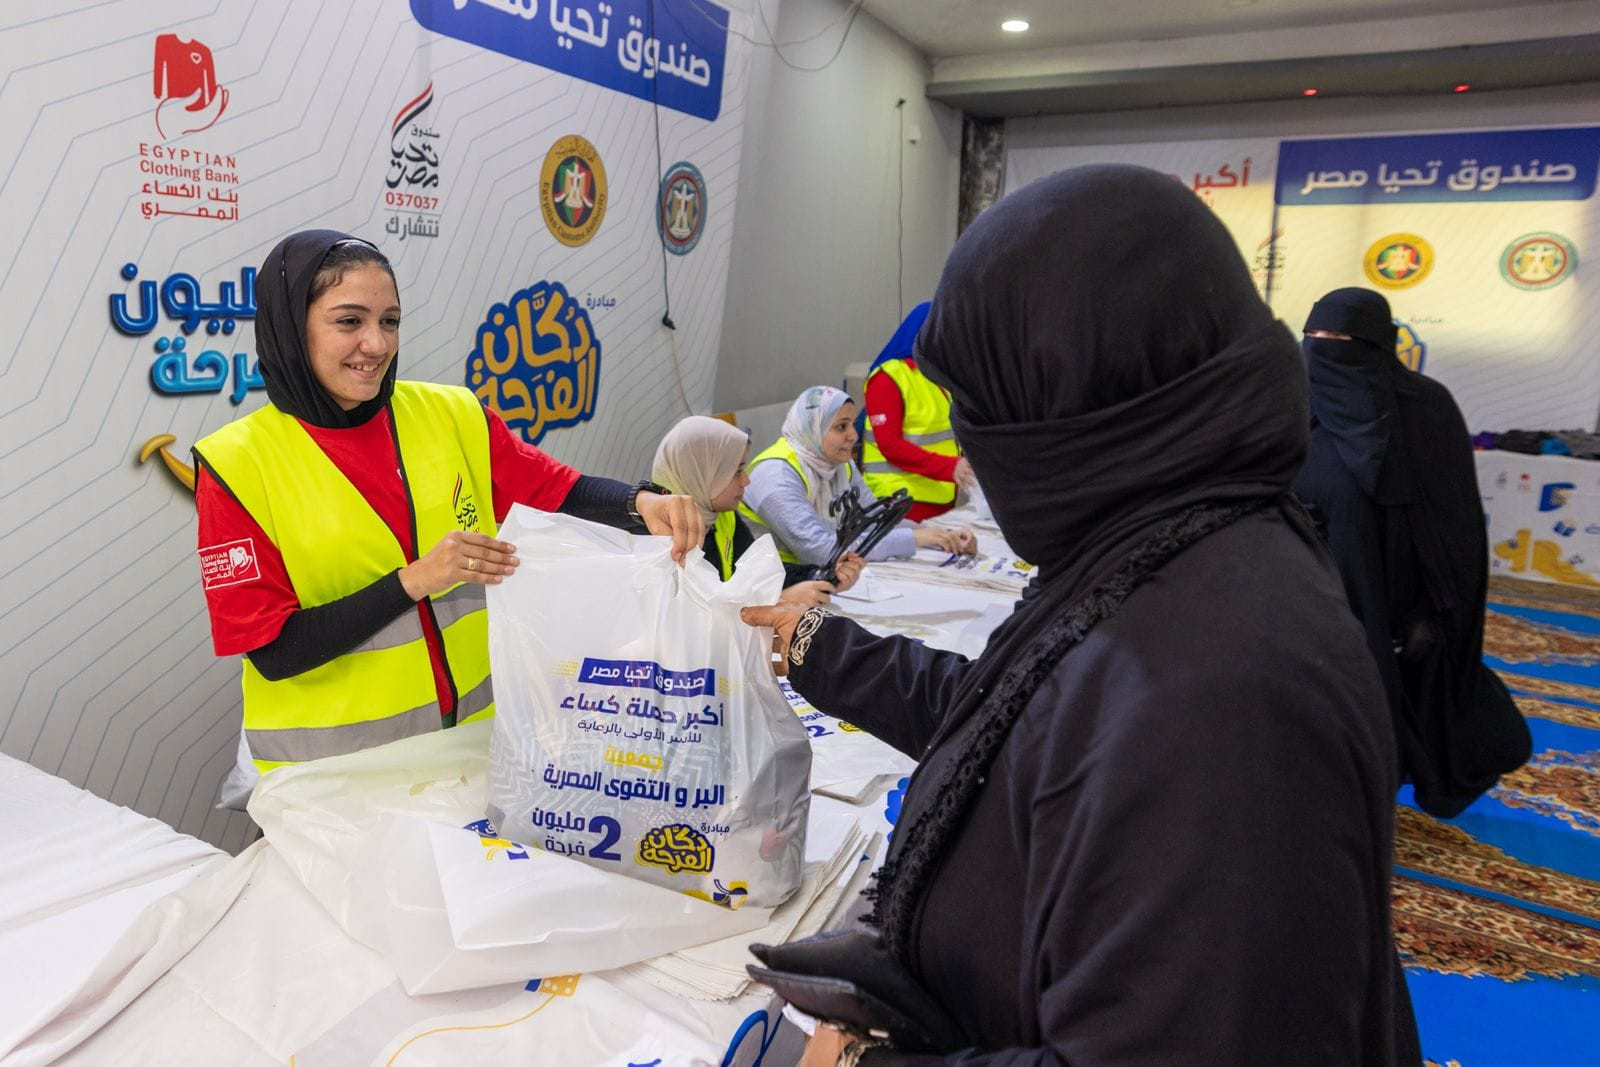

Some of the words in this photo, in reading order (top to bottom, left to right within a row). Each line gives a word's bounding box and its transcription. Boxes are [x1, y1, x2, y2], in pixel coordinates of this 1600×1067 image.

[139, 143, 236, 168] EGYPTIAN
[140, 160, 200, 182] Clothing
[205, 168, 239, 184] Bank
[1193, 157, 1252, 193] أكبر
[1300, 168, 1368, 196] مصر
[1377, 160, 1442, 193] تحيا
[1446, 158, 1577, 192] صندوق
[141, 180, 201, 199] الكساء
[207, 187, 238, 203] بنك
[385, 191, 439, 210] 037037
[385, 215, 439, 241] نتشارك
[111, 263, 257, 335] ليون
[586, 292, 617, 311] مبادرة
[588, 665, 620, 680] مصر
[624, 662, 653, 683] تحيا
[655, 670, 706, 692] صندوق
[560, 693, 620, 715] كساء
[626, 697, 677, 724] حملة
[577, 719, 622, 735] بالرعاية
[682, 703, 725, 731] أكبر
[624, 727, 665, 742] الأولى
[806, 725, 834, 738] 2
[604, 744, 663, 773] جمعية
[543, 763, 602, 792] المصرية
[604, 777, 671, 802] التقوى
[674, 785, 688, 808] و
[691, 784, 725, 810] البر
[532, 807, 586, 833] مليون
[700, 822, 730, 836] مبادرة
[545, 835, 585, 857] فرحة
[588, 815, 621, 862] 2
